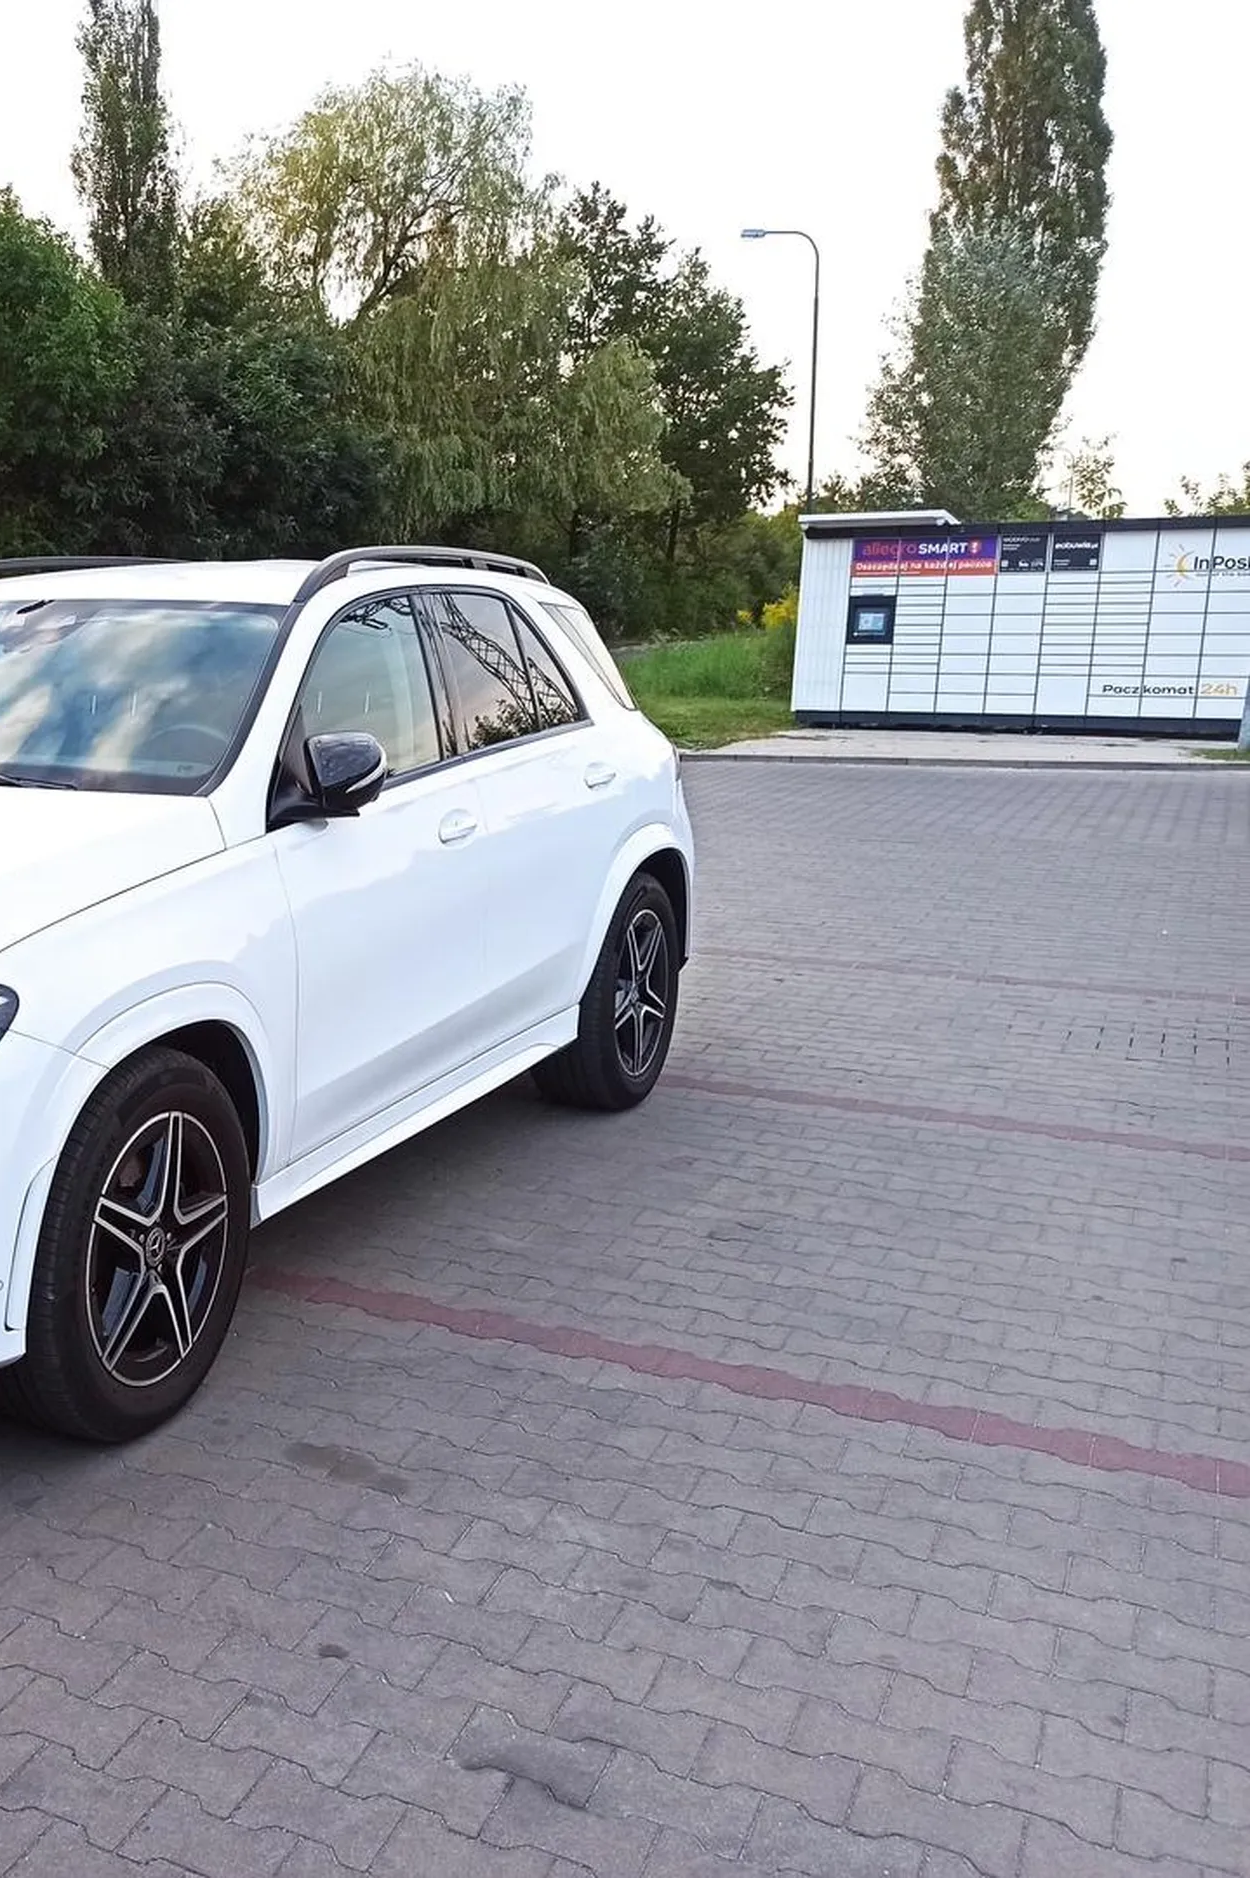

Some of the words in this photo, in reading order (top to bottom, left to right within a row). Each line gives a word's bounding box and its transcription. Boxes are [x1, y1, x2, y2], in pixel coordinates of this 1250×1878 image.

[1193, 555, 1250, 571] InPos
[1102, 683, 1194, 695] Paczkomat
[1200, 682, 1238, 696] 24h
